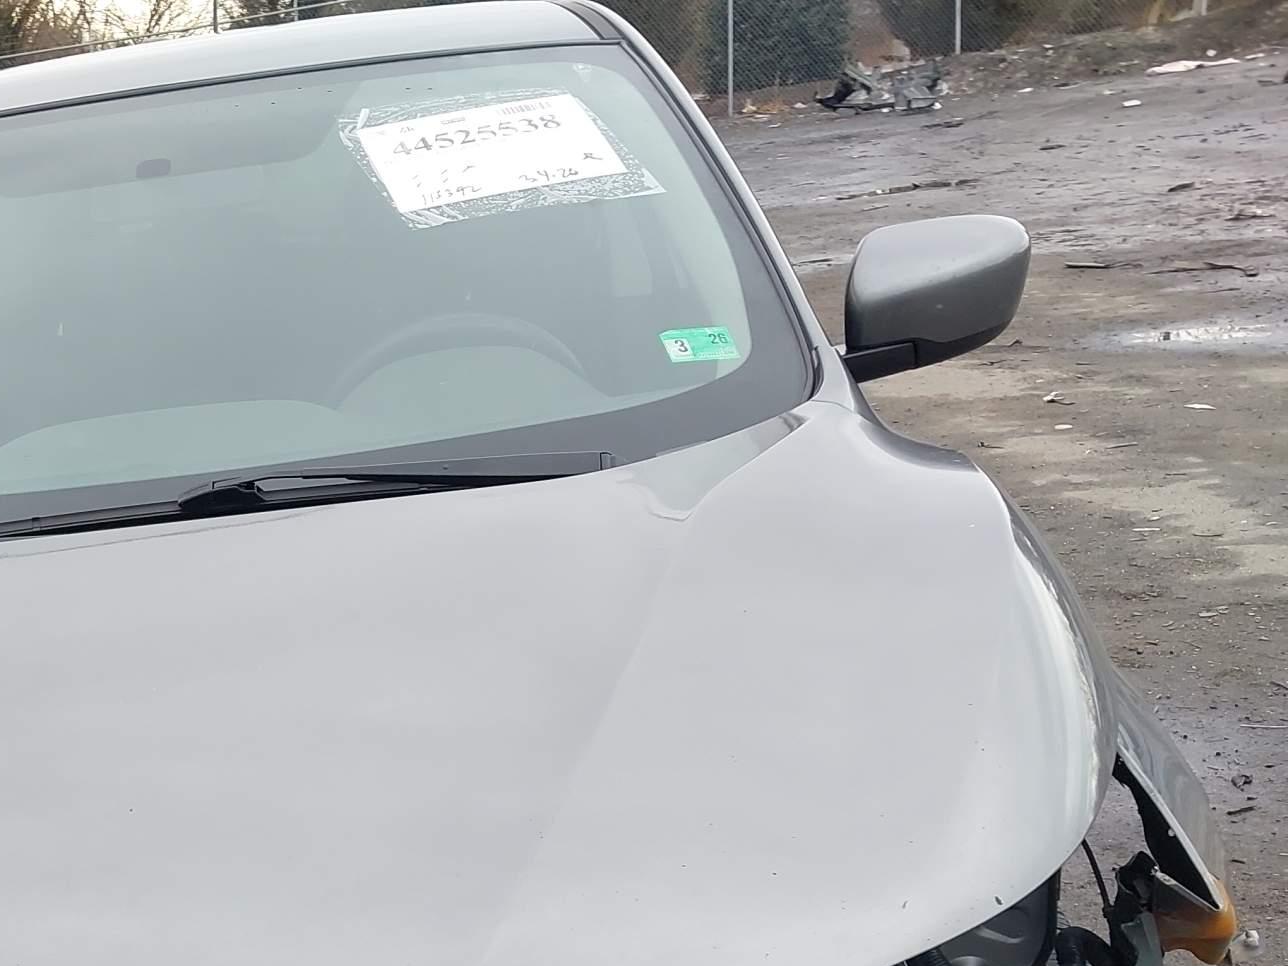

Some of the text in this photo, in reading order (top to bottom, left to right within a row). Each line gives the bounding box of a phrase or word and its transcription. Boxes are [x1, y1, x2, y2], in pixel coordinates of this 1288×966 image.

[392, 114, 561, 156] 44525538
[674, 333, 728, 352] 3 26
